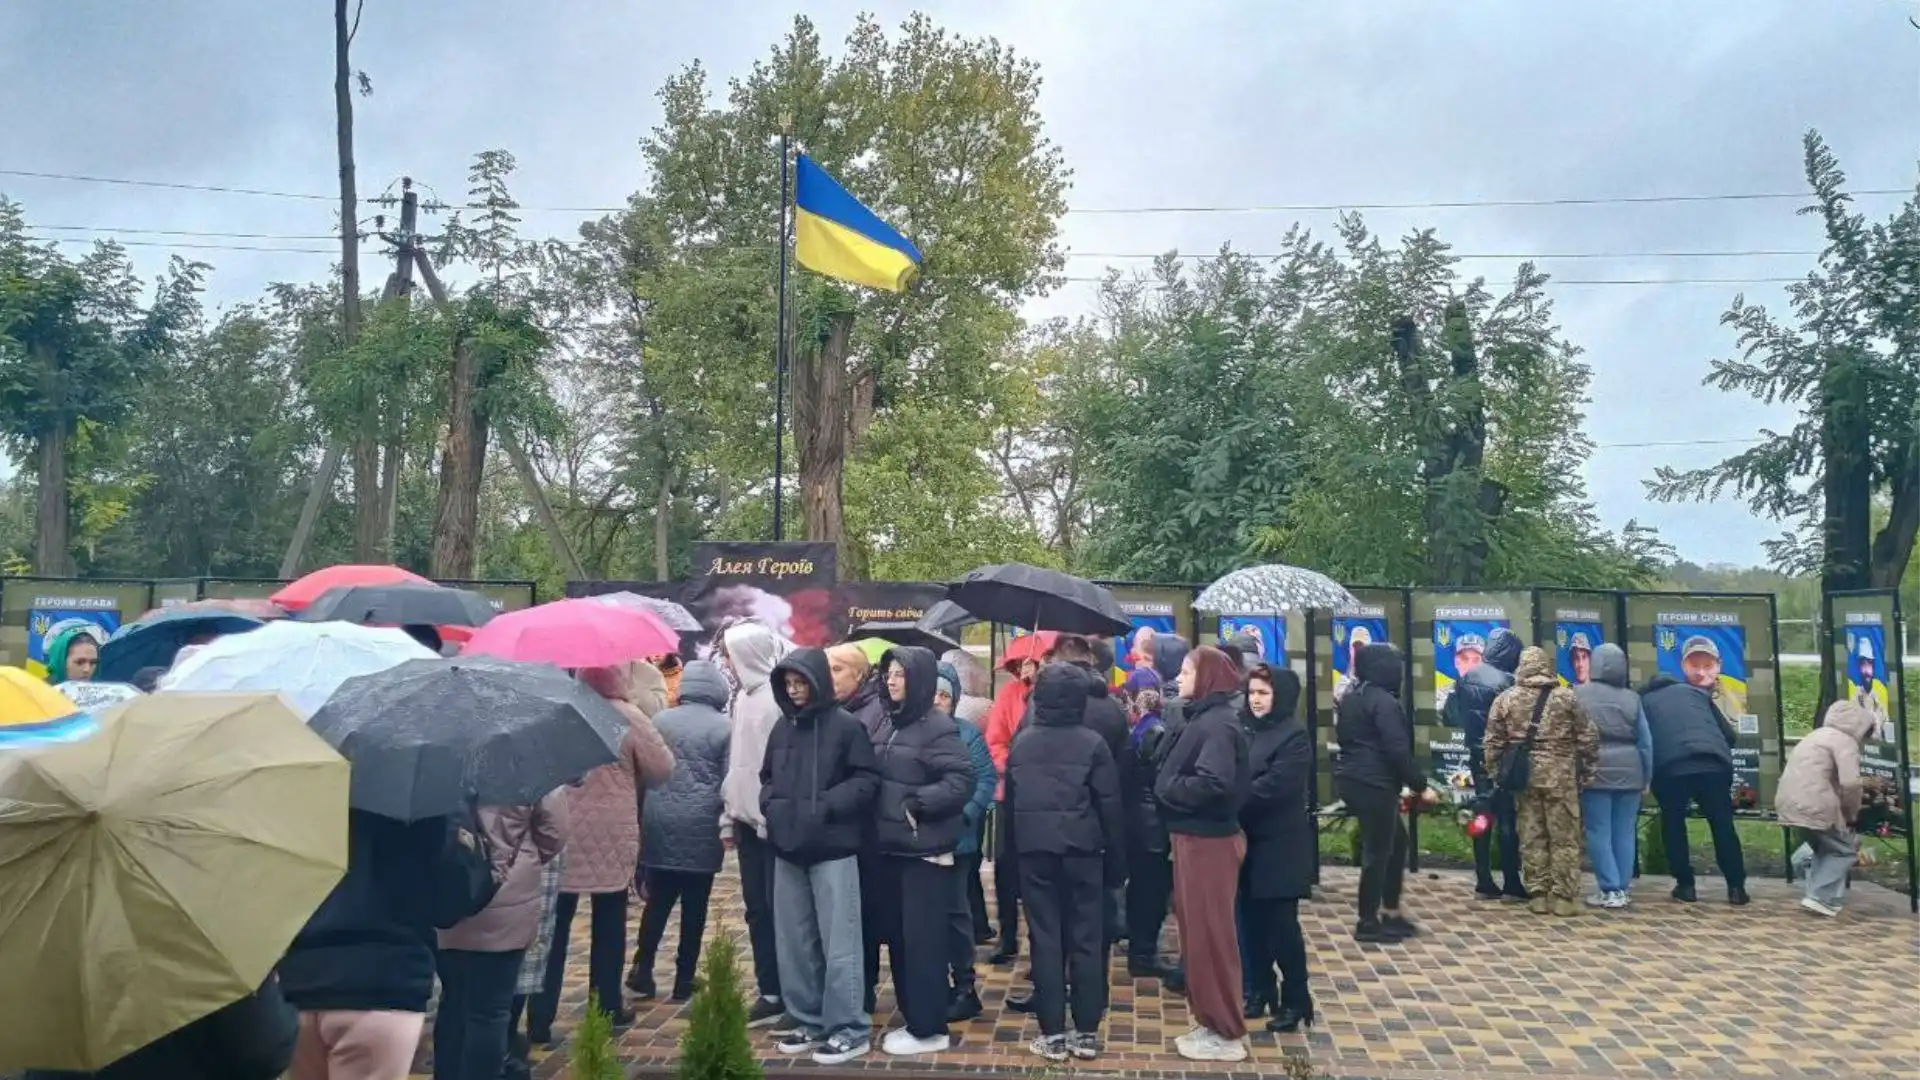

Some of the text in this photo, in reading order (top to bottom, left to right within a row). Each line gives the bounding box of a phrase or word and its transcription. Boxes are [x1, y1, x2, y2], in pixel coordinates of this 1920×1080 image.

[704, 557, 813, 580] Алея Героїв
[848, 606, 893, 620] Горить
